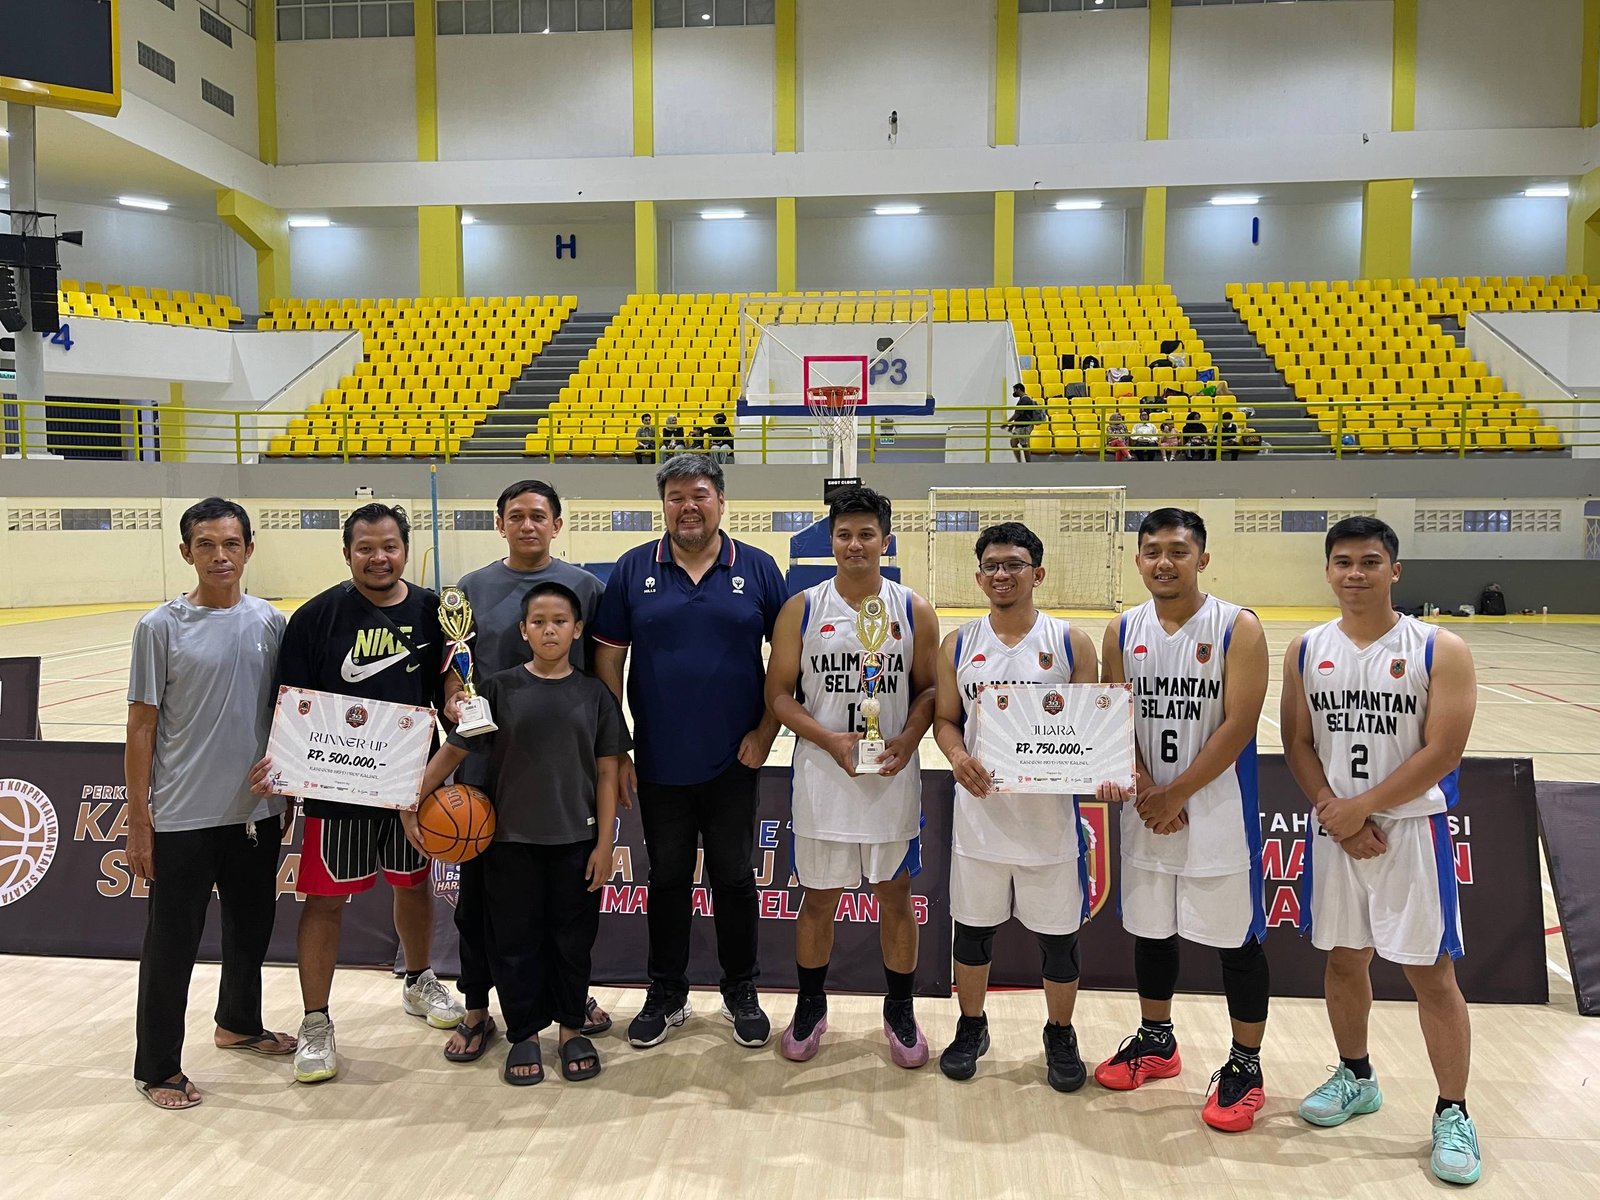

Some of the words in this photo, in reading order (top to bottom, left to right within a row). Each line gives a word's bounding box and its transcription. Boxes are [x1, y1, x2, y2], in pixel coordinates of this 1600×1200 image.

[556, 234, 576, 259] H
[869, 358, 907, 386] P3
[825, 674, 897, 693] SELAN
[1141, 699, 1201, 720] SELATAN
[1309, 690, 1417, 715] KALIMANTAN
[1030, 724, 1076, 736] JUARA
[1326, 713, 1397, 736] SELATAN
[307, 749, 325, 762] RP.
[1016, 742, 1033, 754] RP.
[1161, 729, 1178, 763] 6
[1351, 744, 1369, 779] 2
[7, 780, 44, 804] KORPRI
[40, 801, 57, 875] KALIMANTAN
[1, 874, 39, 904] SELATA
